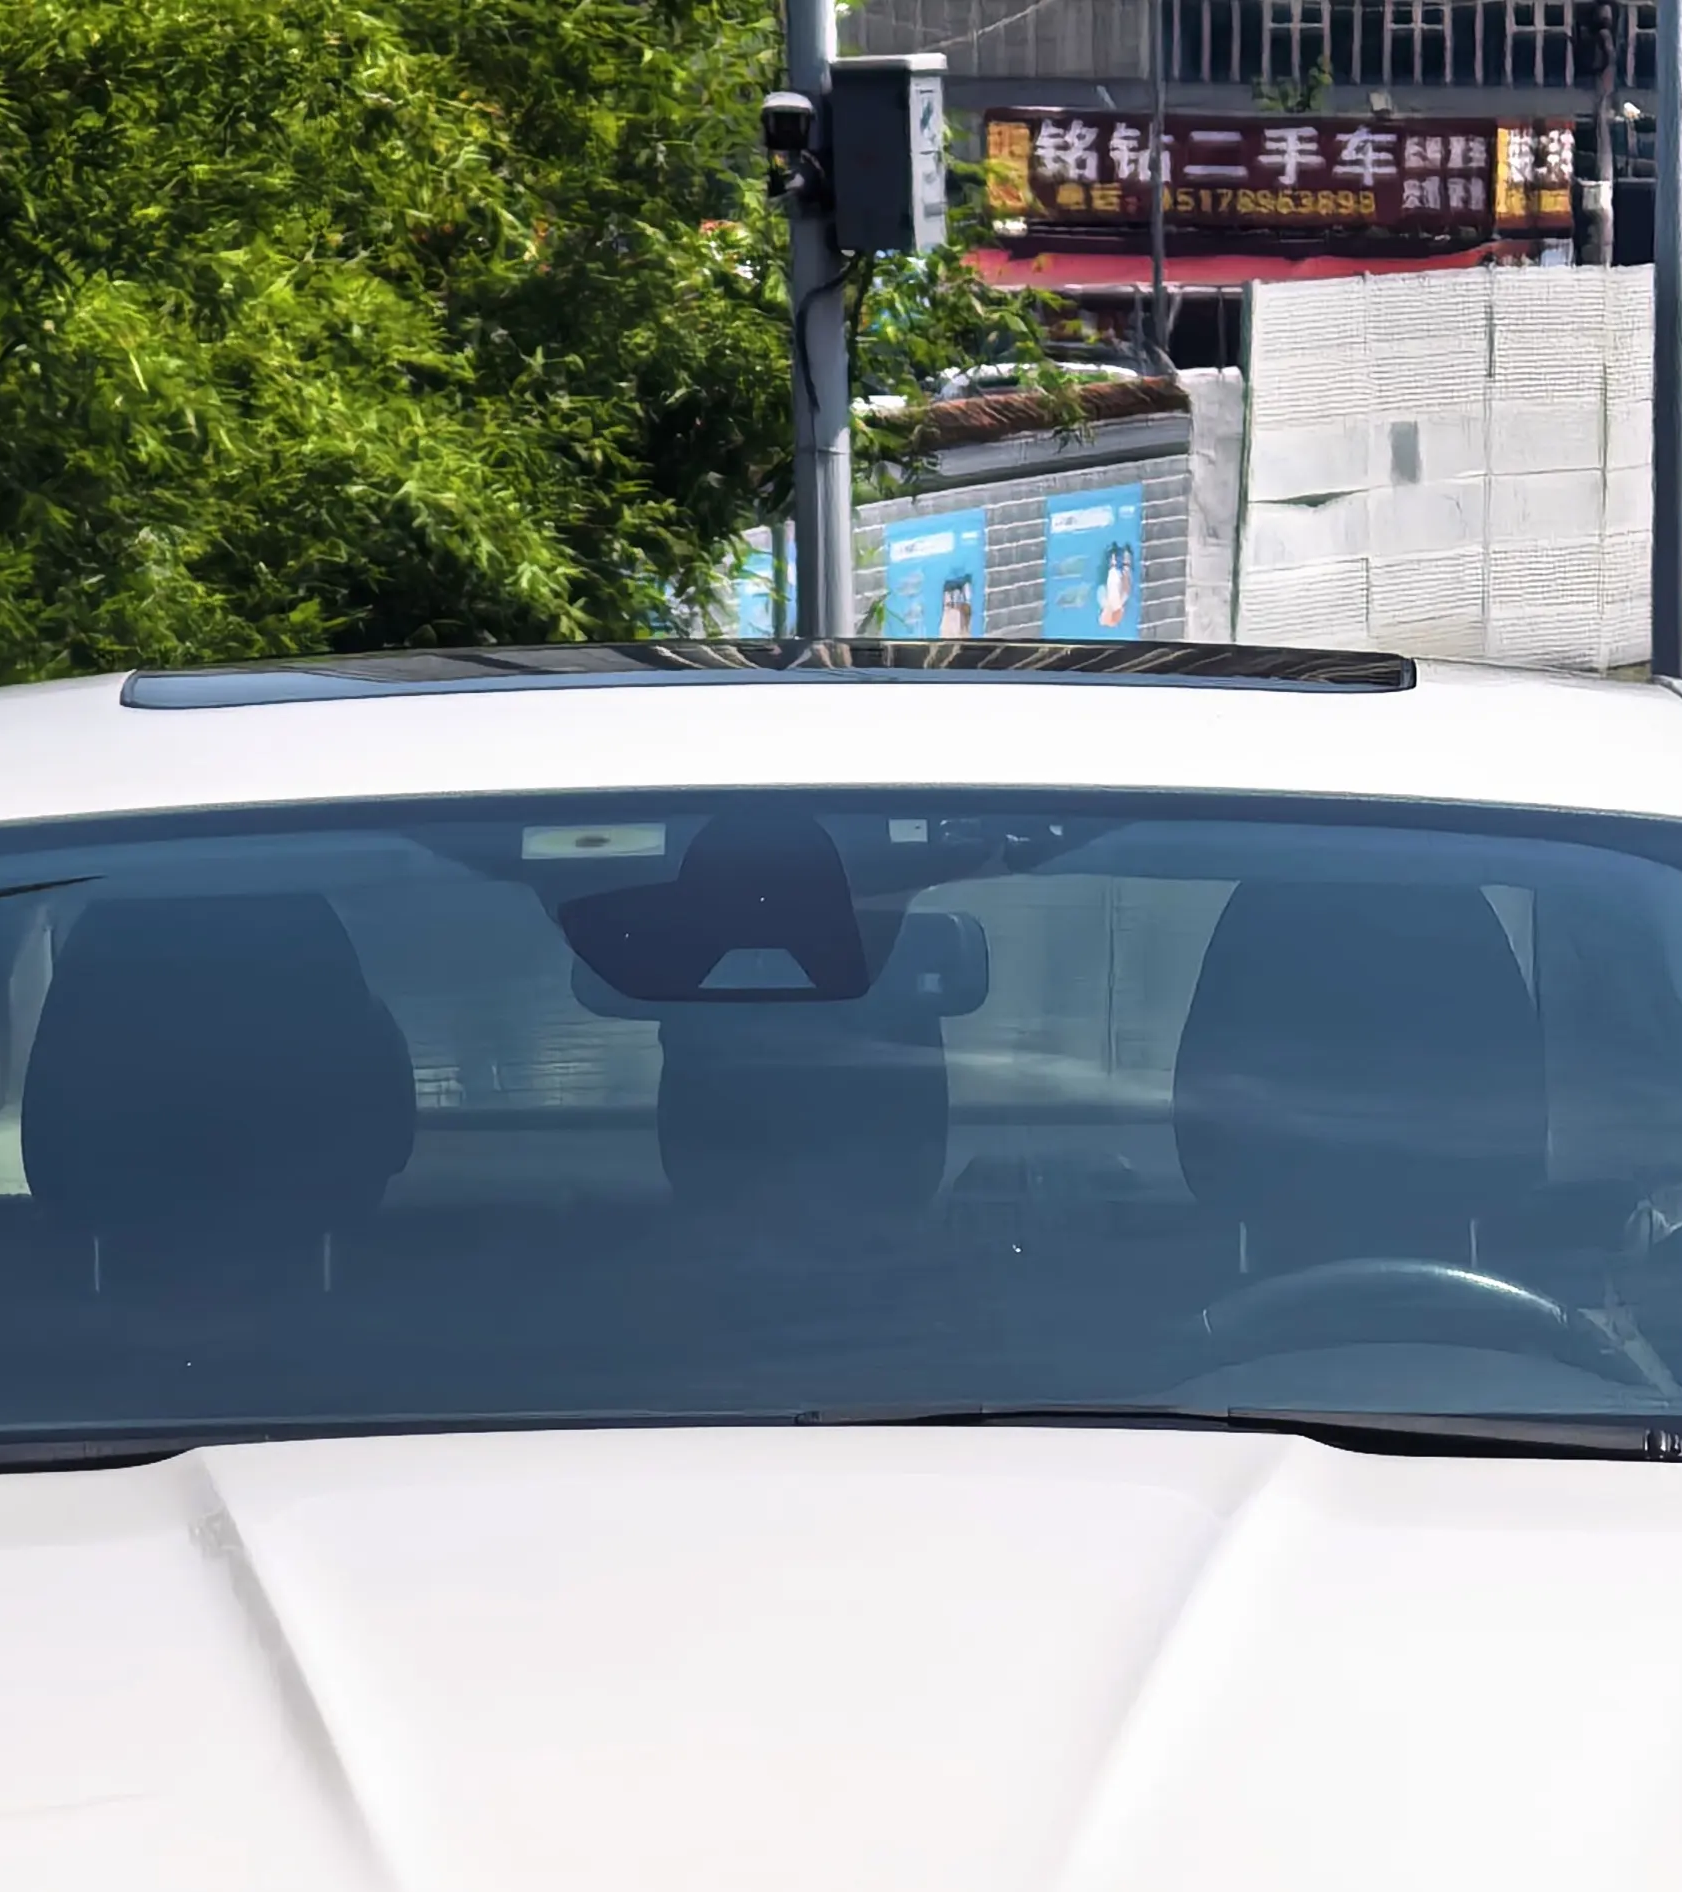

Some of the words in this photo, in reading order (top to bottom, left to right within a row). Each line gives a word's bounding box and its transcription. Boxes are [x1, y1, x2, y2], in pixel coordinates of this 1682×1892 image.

[1035, 119, 1397, 186] 铭钻二手车
